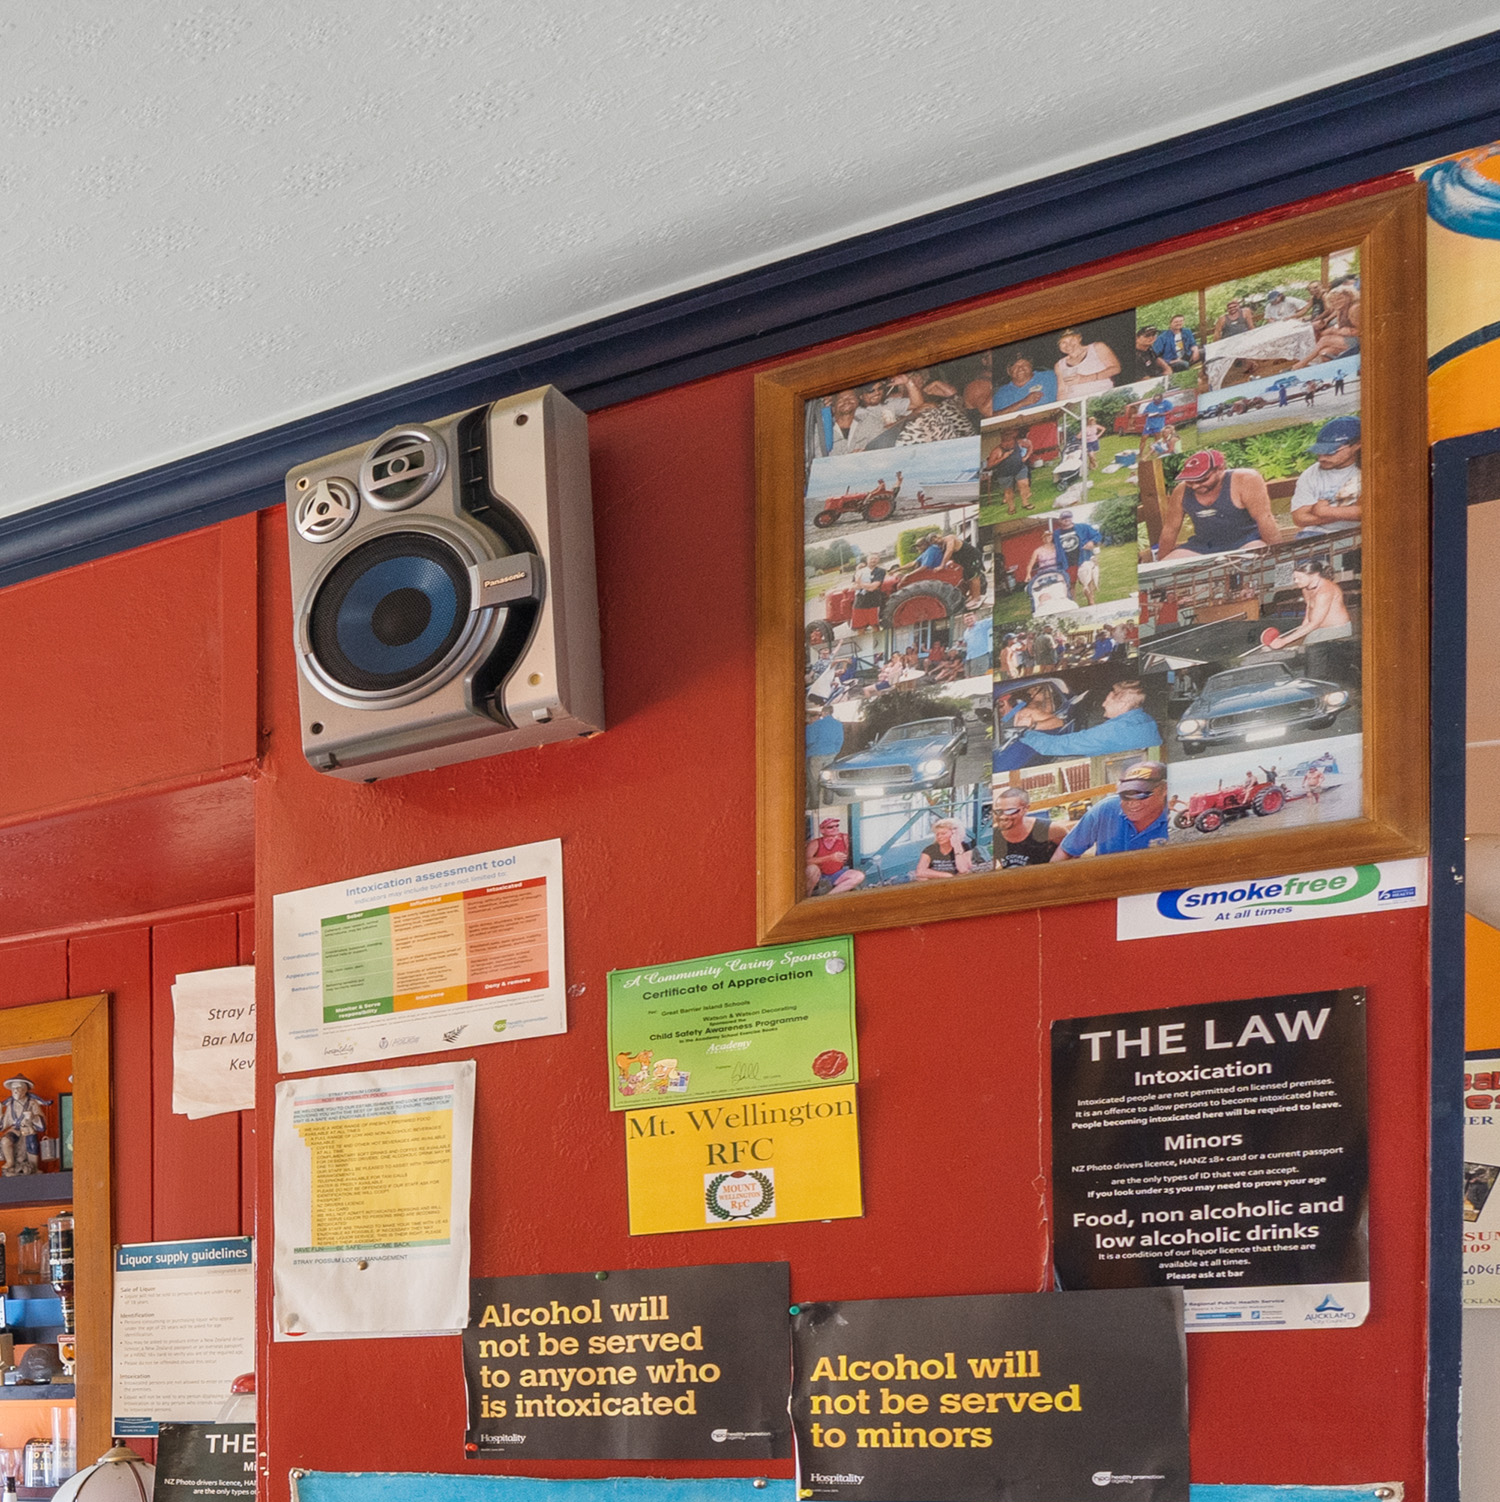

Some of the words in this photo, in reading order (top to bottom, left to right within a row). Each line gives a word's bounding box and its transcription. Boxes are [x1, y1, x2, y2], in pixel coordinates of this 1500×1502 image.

[484, 572, 526, 588] Panasonic
[346, 877, 411, 895] Intoxication
[415, 862, 488, 882] assessment
[491, 856, 515, 868] tool
[1185, 873, 1348, 908] smokefree
[1215, 912, 1230, 921] At
[1234, 907, 1250, 918] all
[1255, 903, 1295, 916] times
[623, 975, 640, 989] A
[644, 967, 723, 985] Community
[726, 957, 776, 973] Caring
[780, 950, 840, 966] Sponsor
[642, 984, 707, 1000] Certificate
[712, 980, 723, 990] of
[727, 970, 812, 988] Appreciation
[208, 1007, 244, 1020] Stray
[649, 1032, 672, 1040] Child
[675, 1029, 702, 1037] Safety
[705, 1023, 752, 1034] Awareness
[755, 1015, 808, 1027] Programme
[1079, 1023, 1186, 1061] THE
[1205, 1008, 1330, 1050] LAW
[202, 1035, 226, 1047] Bar
[707, 1040, 752, 1052] Academy
[1135, 1062, 1271, 1085] Intoxication
[1077, 1095, 1125, 1106] Intoxicated
[1126, 1093, 1156, 1103] people
[1190, 1086, 1235, 1097] permitted
[1250, 1081, 1287, 1090] licensed
[1289, 1078, 1334, 1089] premises.
[1104, 1107, 1136, 1115] offence
[1173, 1101, 1208, 1111] persons
[1221, 1097, 1258, 1105] become
[1259, 1092, 1311, 1101] intoxicated
[629, 1115, 675, 1140] Mt.
[687, 1099, 854, 1132] Wellington
[1072, 1120, 1101, 1129] People
[1103, 1117, 1147, 1126] becoming
[1149, 1112, 1201, 1122] intoxicated
[1257, 1105, 1298, 1114] required
[706, 1137, 775, 1166] RFC
[1165, 1134, 1242, 1150] Minors
[718, 1191, 761, 1200] WELLINGTON
[722, 1182, 758, 1193] MOUNT
[1217, 1181, 1240, 1189] need
[1254, 1180, 1282, 1188] prove
[1283, 1178, 1306, 1186] your
[1308, 1177, 1326, 1185] age
[1073, 1209, 1134, 1227] Food,
[1142, 1210, 1183, 1223] non
[1190, 1200, 1292, 1220] alcoholic
[1299, 1196, 1343, 1213] and
[1096, 1234, 1135, 1248] low
[1140, 1227, 1240, 1246] alcoholic
[1246, 1223, 1319, 1240] drinks
[120, 1254, 152, 1267] Liquor
[155, 1250, 188, 1265] supply
[191, 1247, 247, 1263] guidelines
[479, 1299, 602, 1327] Alcohol
[610, 1295, 669, 1321] will
[479, 1334, 529, 1357] not
[538, 1332, 579, 1355] be
[588, 1326, 703, 1354] served
[480, 1365, 510, 1387] to
[519, 1366, 636, 1391] anyone
[646, 1358, 720, 1383] who
[810, 1352, 956, 1381] Alcohol
[967, 1350, 1040, 1378] will
[481, 1395, 506, 1417] is
[515, 1390, 696, 1417] intoxicated
[810, 1389, 870, 1414] not
[880, 1388, 928, 1414] be
[940, 1384, 1081, 1413] served
[205, 1434, 256, 1453] THE
[480, 1433, 526, 1444] Hospitality
[810, 1423, 846, 1447] to
[856, 1422, 992, 1447] minors
[810, 1472, 865, 1485] Hospitality
